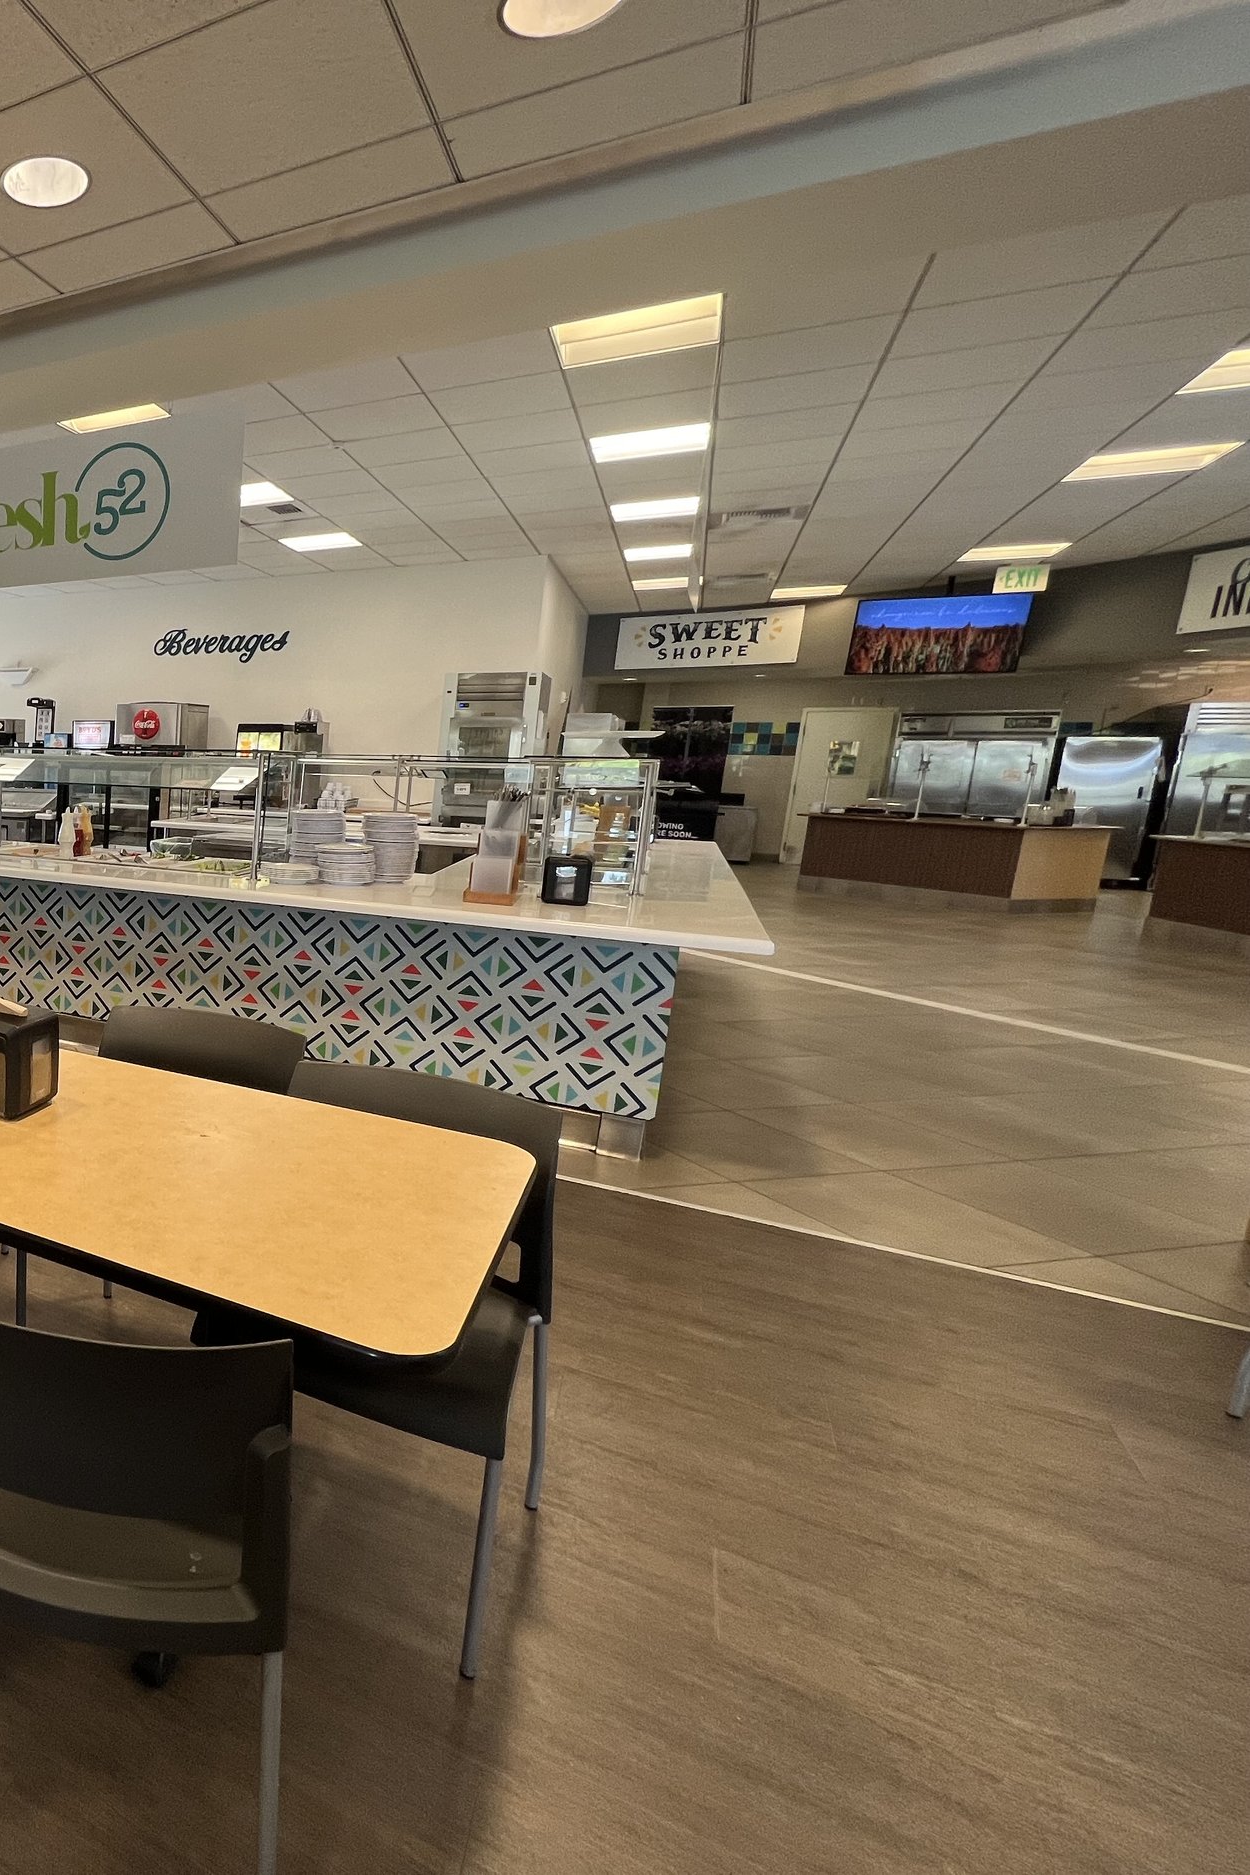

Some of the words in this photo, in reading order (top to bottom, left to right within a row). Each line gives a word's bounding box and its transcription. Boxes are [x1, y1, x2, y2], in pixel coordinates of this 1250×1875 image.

[93, 468, 146, 535] 52
[1004, 567, 1040, 589] EXIT
[1210, 580, 1250, 619] IN
[153, 628, 290, 664] Beverages
[648, 616, 767, 649] SWEET
[657, 644, 749, 660] SHOPPE
